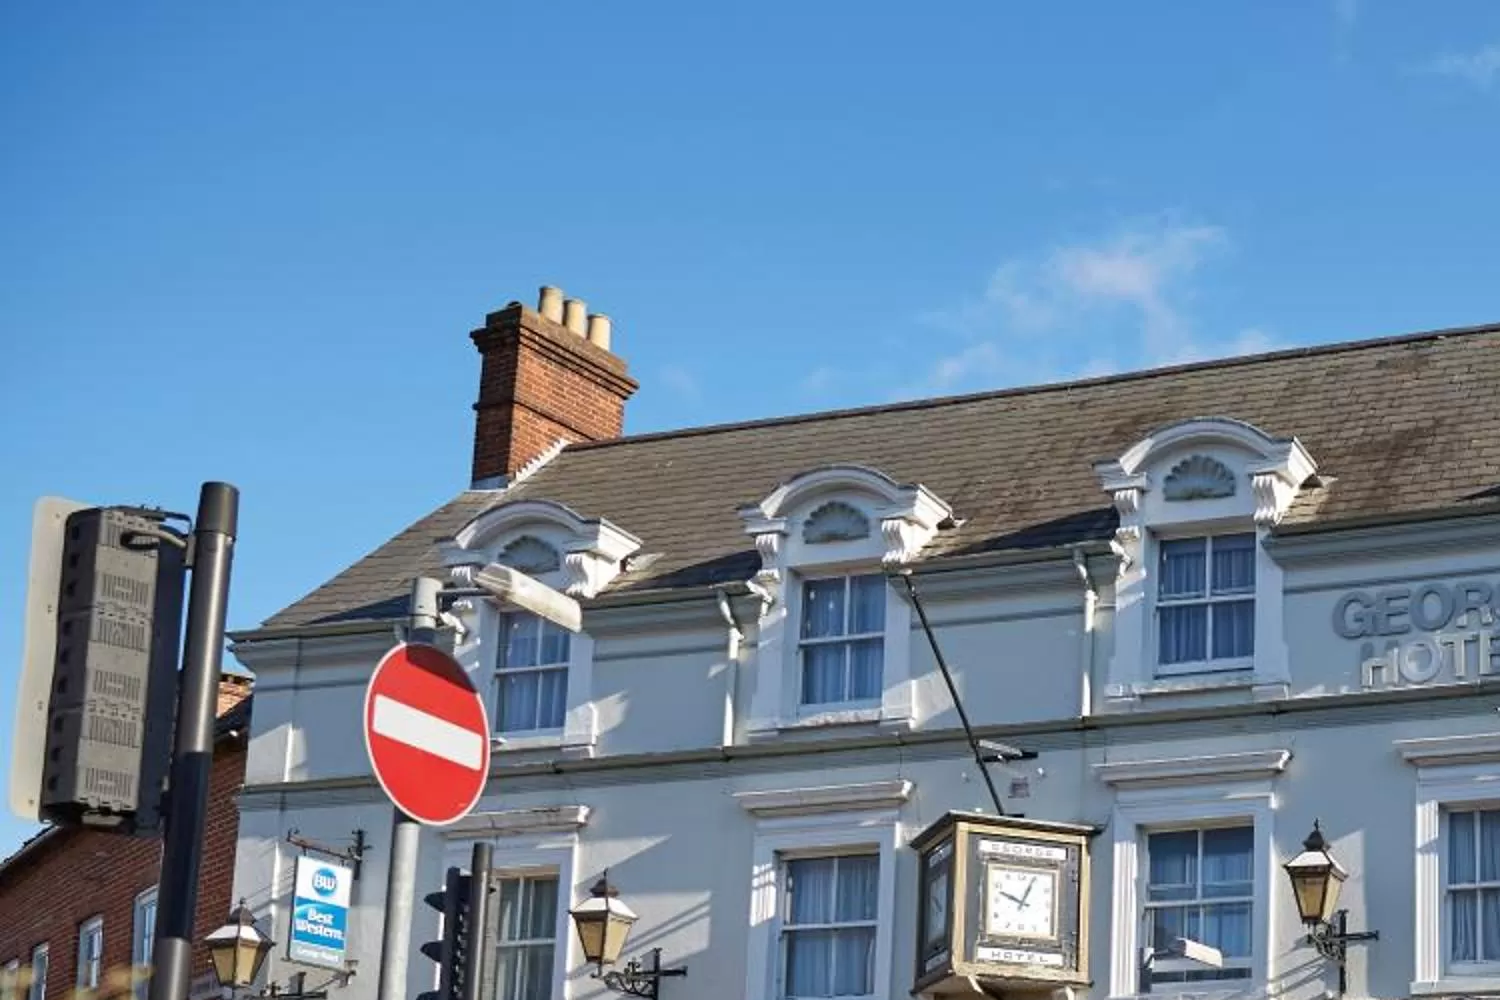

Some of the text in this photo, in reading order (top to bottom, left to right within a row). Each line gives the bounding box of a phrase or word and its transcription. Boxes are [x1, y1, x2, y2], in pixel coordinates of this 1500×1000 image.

[314, 874, 335, 889] BW
[307, 907, 335, 926] Best
[991, 950, 1049, 963] HOTEL
